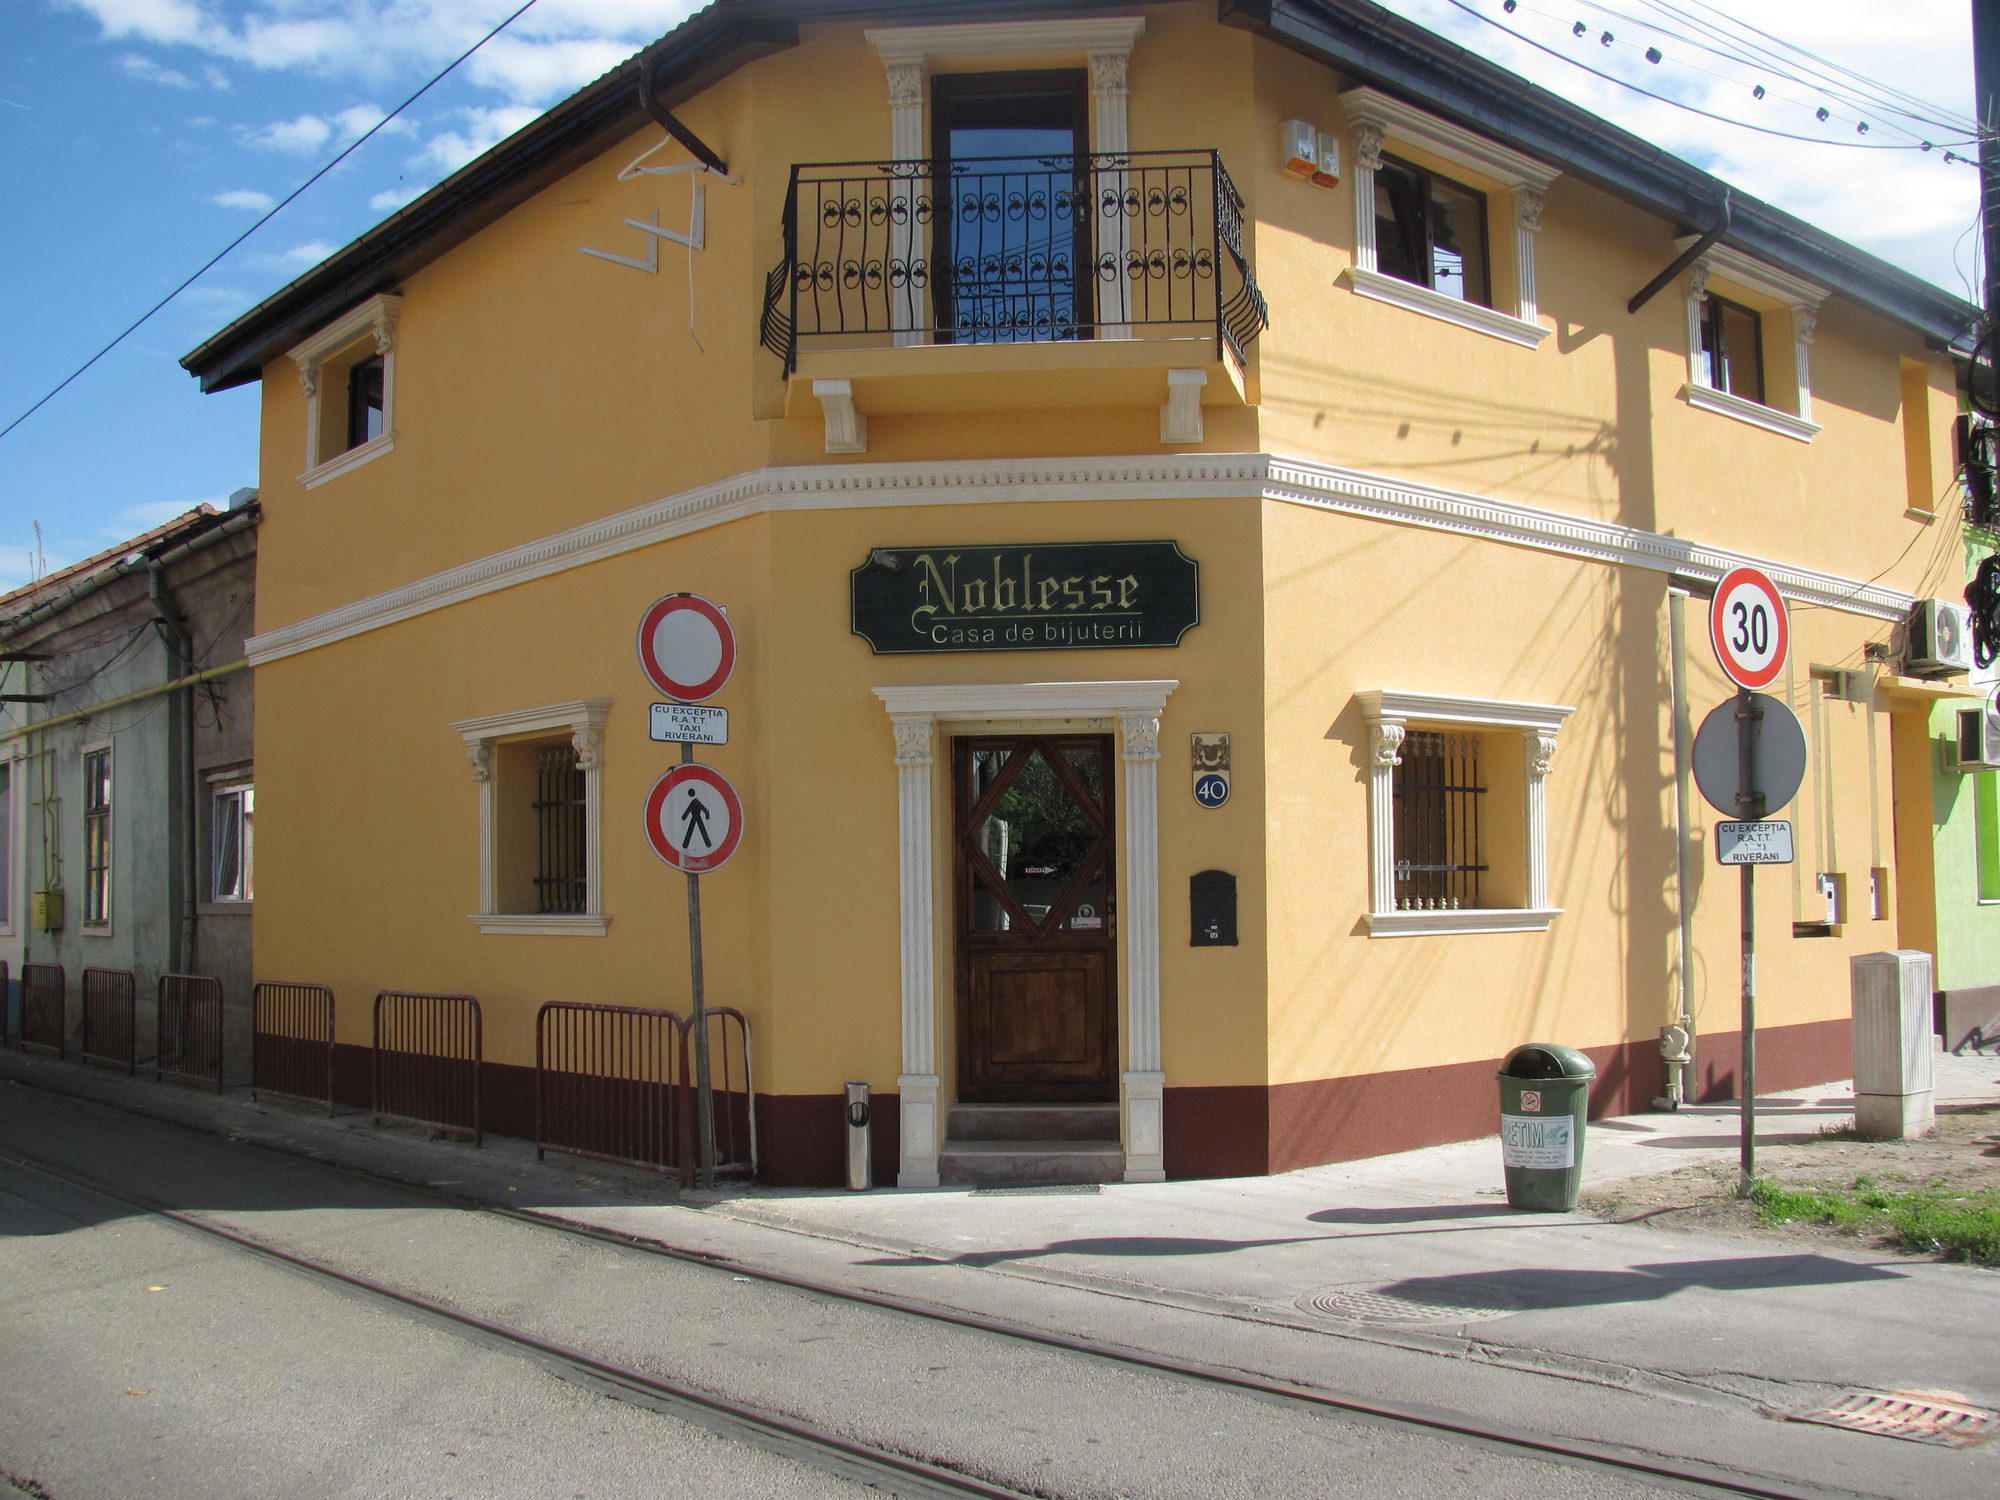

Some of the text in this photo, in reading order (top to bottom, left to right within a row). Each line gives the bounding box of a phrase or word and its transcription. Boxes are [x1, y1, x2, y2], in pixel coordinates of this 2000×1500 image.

[912, 554, 1139, 634] Noblesse
[932, 620, 1142, 644] Casa de bijuterii
[1732, 601, 1768, 655] 30
[655, 705, 670, 713] CU
[671, 715, 707, 725] R.A.T.T.
[679, 724, 700, 732] TAXI
[664, 732, 713, 741] RIVERANI
[1198, 781, 1226, 800] 40
[1721, 824, 1736, 832] CU
[1737, 834, 1771, 842] R.A.T.T.
[1732, 853, 1780, 861] RIVERANI
[1503, 1121, 1544, 1148] RETIM
